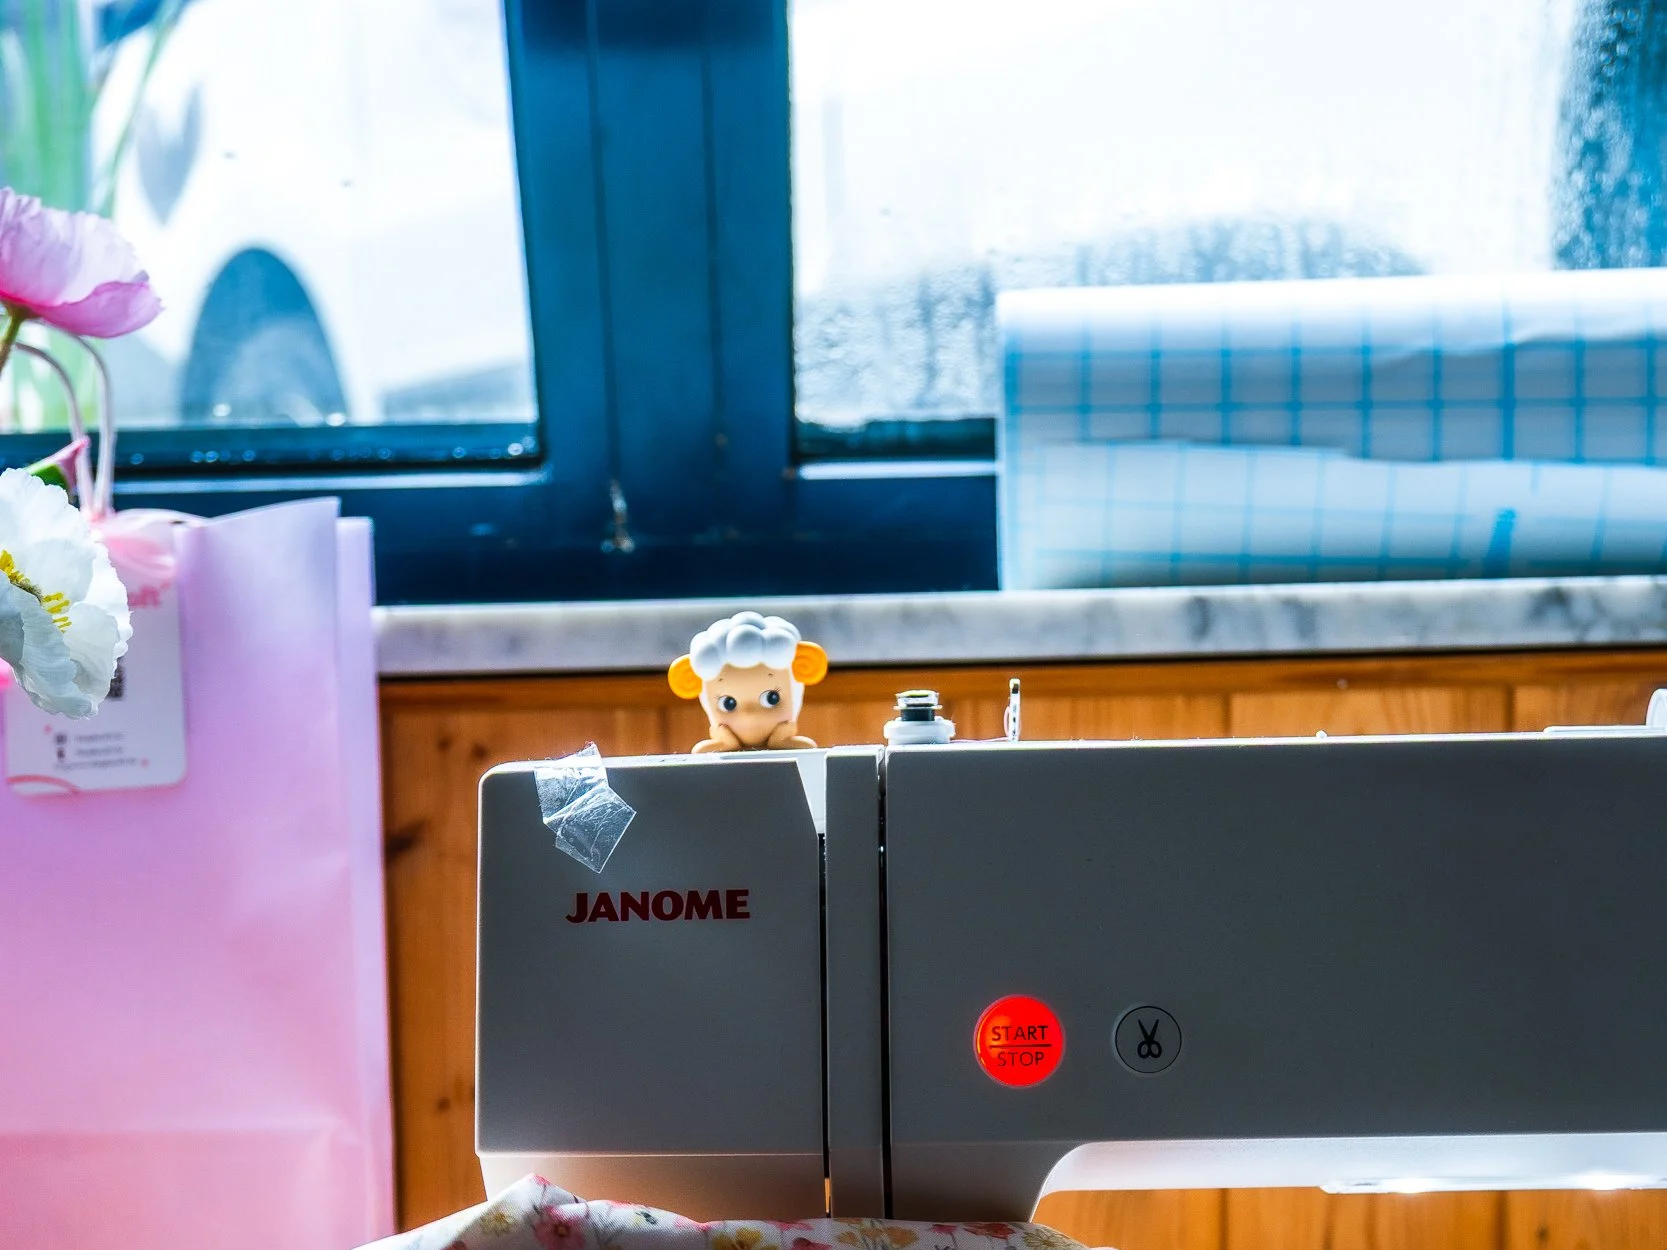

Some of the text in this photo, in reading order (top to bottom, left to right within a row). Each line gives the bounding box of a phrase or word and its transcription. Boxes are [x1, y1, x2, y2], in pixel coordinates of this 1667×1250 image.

[565, 889, 750, 923] JANOME
[991, 1025, 1049, 1041] START
[997, 1051, 1045, 1067] STOP
